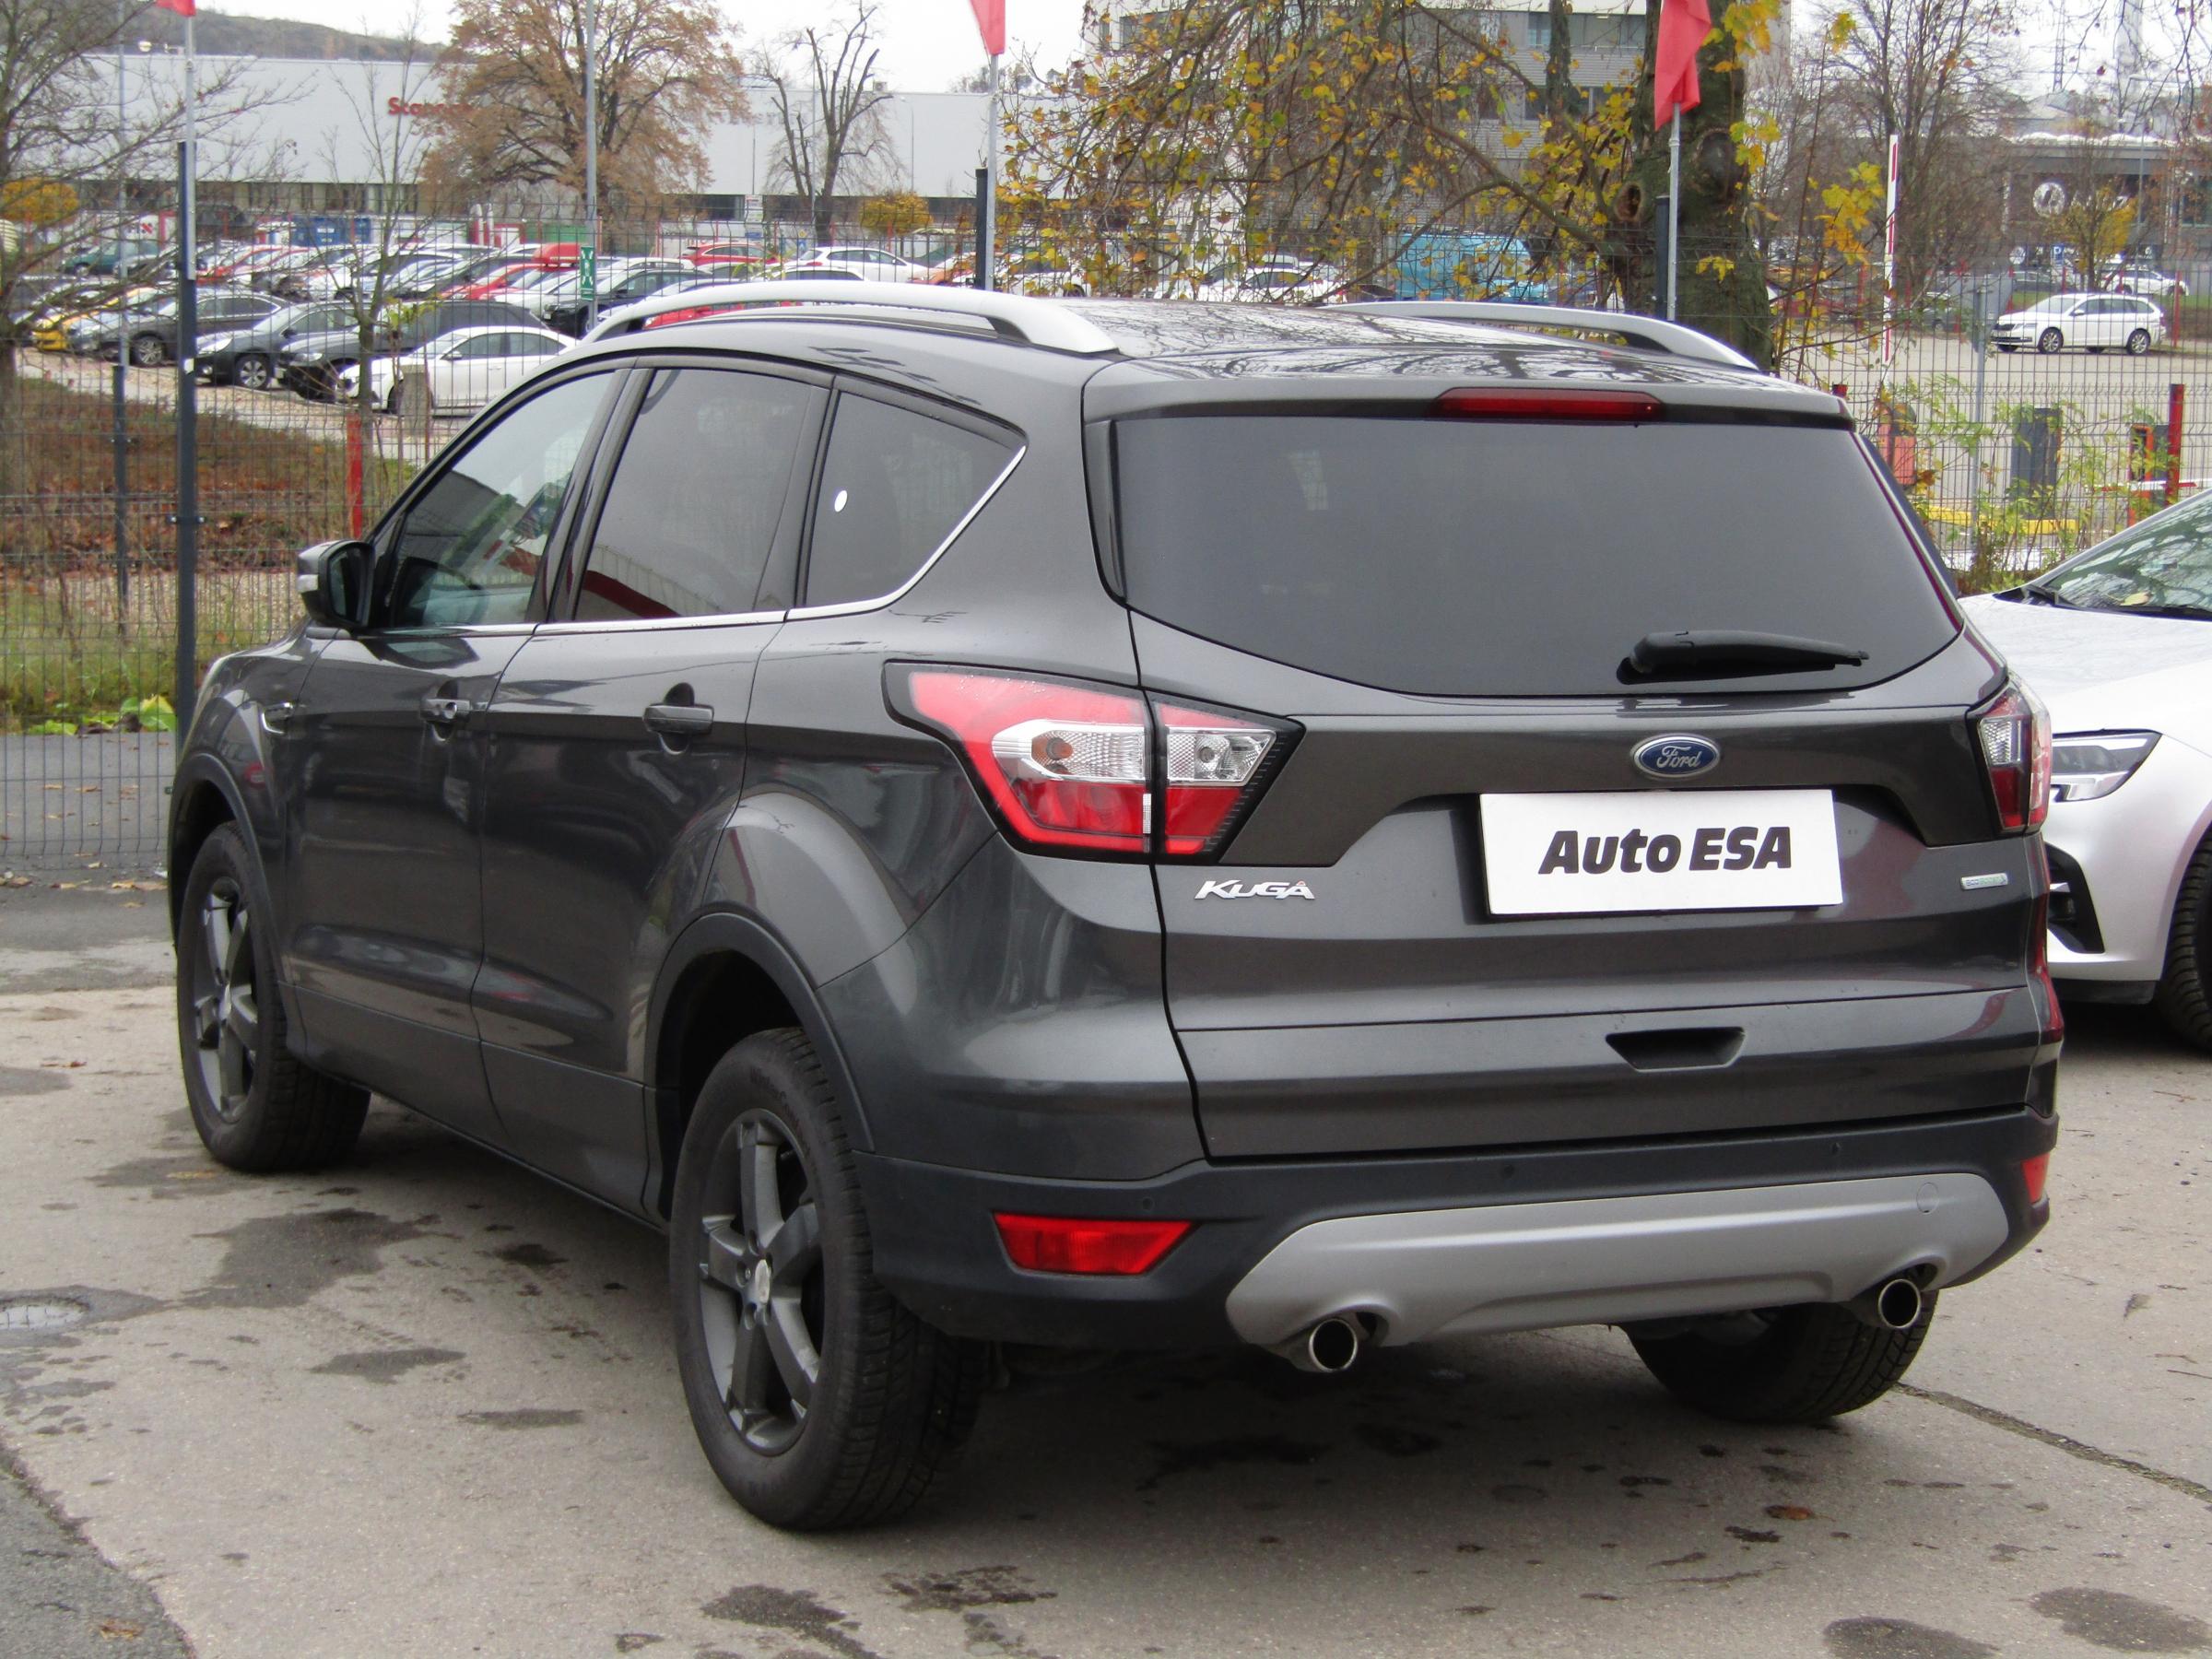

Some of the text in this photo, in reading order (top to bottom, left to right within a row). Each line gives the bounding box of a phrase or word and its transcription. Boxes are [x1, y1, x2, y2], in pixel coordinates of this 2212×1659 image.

[1656, 745, 1702, 769] Ford
[1538, 827, 1792, 875] Auto ESA
[1194, 879, 1315, 900] KUGA
